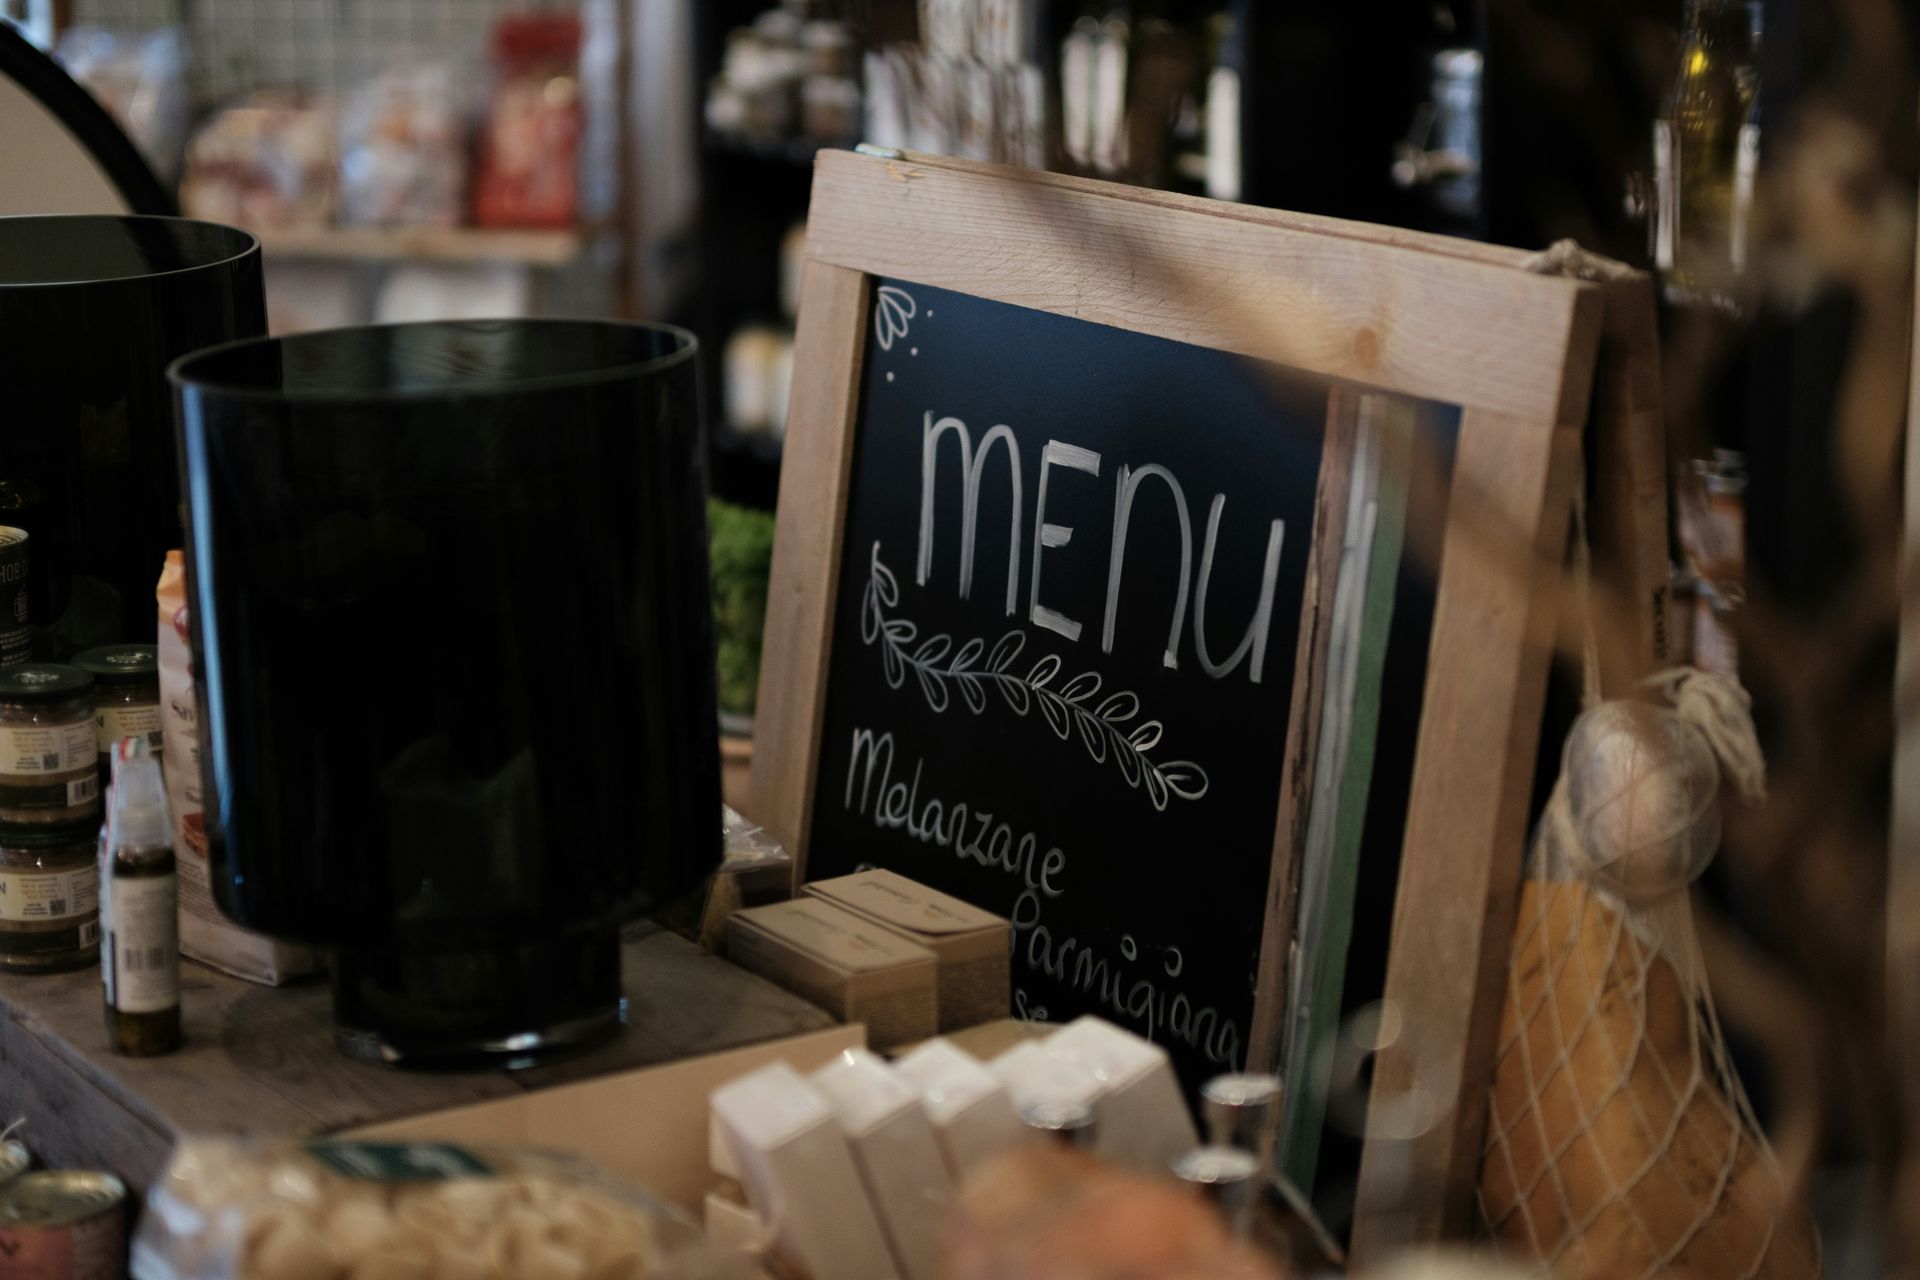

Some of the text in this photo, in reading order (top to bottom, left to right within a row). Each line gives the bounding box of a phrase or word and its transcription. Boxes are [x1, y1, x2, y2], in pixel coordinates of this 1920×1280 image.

[917, 410, 1285, 684] MENU
[845, 727, 1066, 896] Melanzane
[1010, 889, 1240, 1073] Parmigiana
